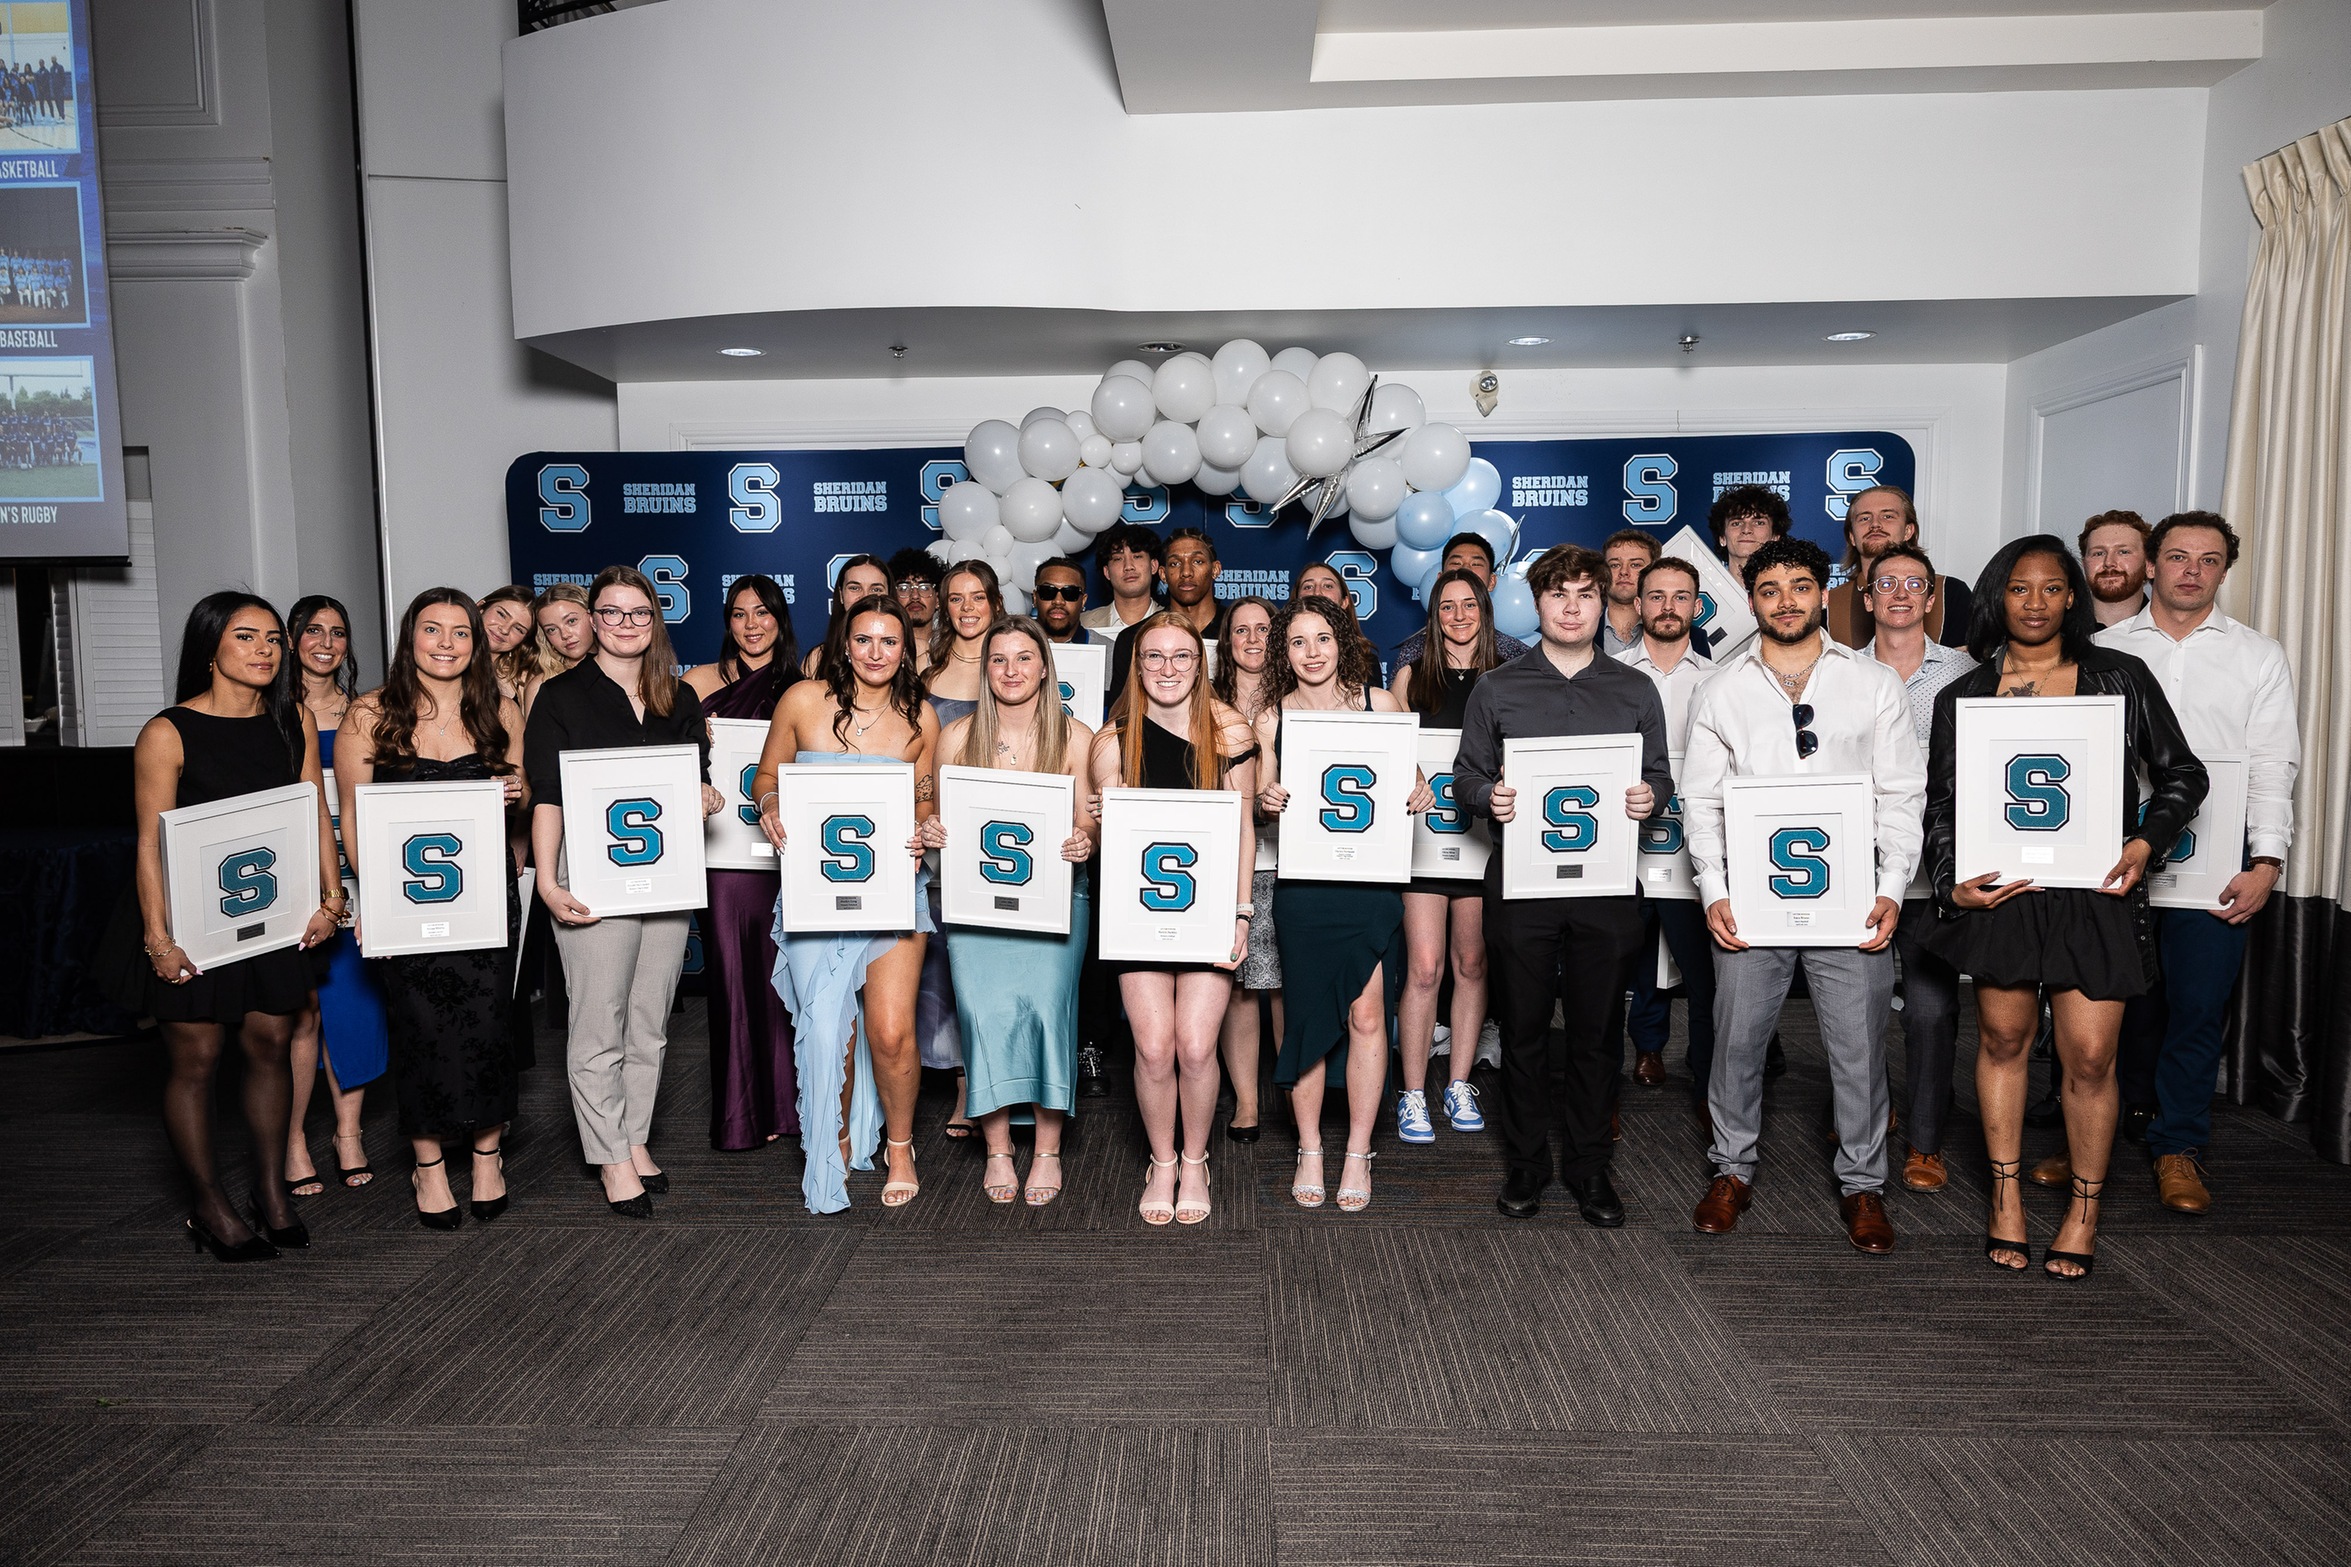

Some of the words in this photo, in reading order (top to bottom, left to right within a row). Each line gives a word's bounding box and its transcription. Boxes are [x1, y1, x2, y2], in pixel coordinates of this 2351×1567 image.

[537, 464, 592, 533] S
[623, 483, 696, 496] SHERIDAN
[624, 497, 697, 514] BRUINS
[728, 463, 782, 533] S
[813, 481, 887, 495] SHERIDAN
[814, 495, 888, 513] BRUINS
[1512, 476, 1589, 489] SHERIDAN
[1512, 490, 1589, 507] BRUINS
[1622, 453, 1679, 525] S
[1713, 471, 1790, 485] SHERIDAN
[1825, 448, 1884, 521] S
[21, 506, 58, 524] RUGBY
[1214, 583, 1290, 600] BRUINS
[1319, 763, 1377, 833] S
[1541, 785, 1600, 853] S
[2004, 753, 2072, 832] S
[606, 797, 664, 867] S
[821, 814, 875, 883] S
[979, 820, 1034, 886] S
[1768, 826, 1830, 899] S
[218, 846, 278, 919] S
[402, 832, 463, 904] S
[1139, 842, 1199, 912] S
